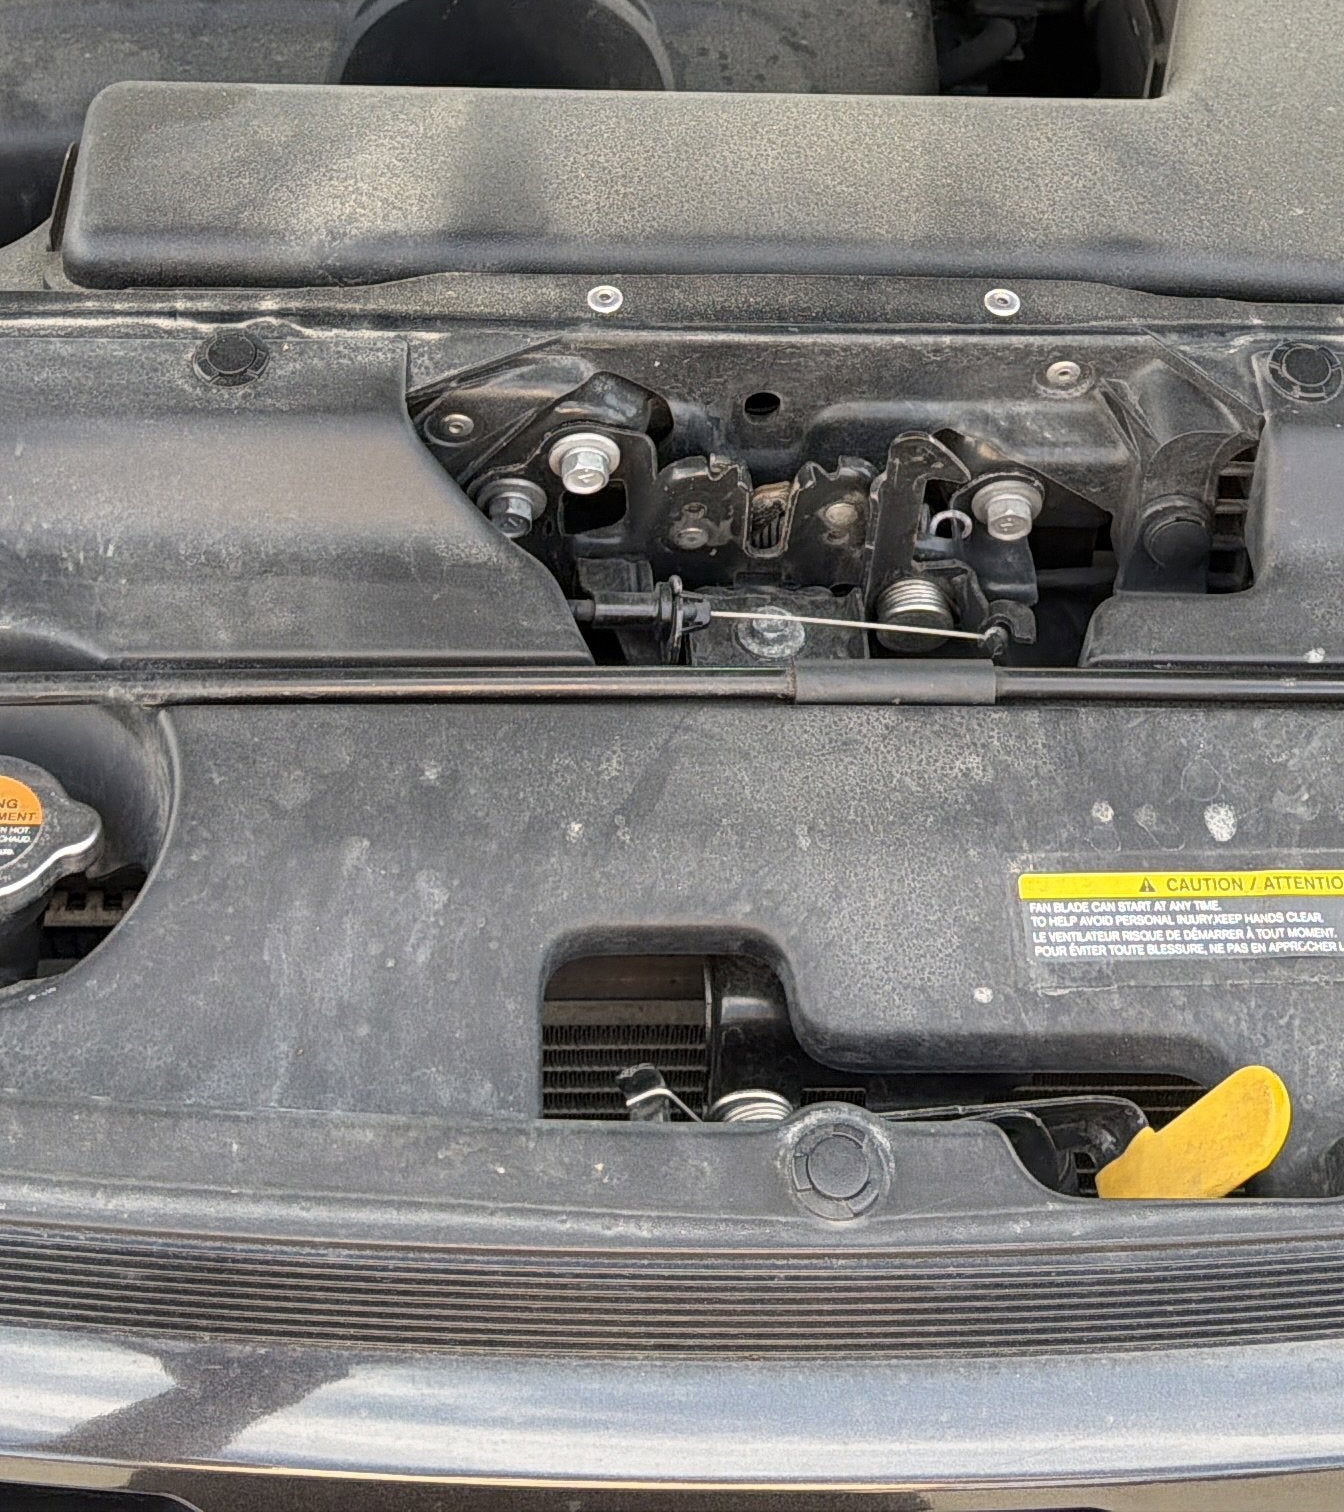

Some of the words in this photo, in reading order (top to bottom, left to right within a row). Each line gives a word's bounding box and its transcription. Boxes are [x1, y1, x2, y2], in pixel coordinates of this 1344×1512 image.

[9, 826, 32, 835] HOT.
[1166, 877, 1244, 892] CAUTION
[1029, 902, 1052, 913] FAN
[1054, 901, 1090, 913] BLADE
[1092, 901, 1116, 912] CAN
[1118, 901, 1152, 912] START
[1154, 901, 1167, 911] AT
[1169, 900, 1192, 911] ANY
[1194, 900, 1222, 911] TIME.
[1030, 916, 1047, 927] TO
[1049, 916, 1078, 927] HELP
[1080, 915, 1114, 926] AVOID
[1115, 915, 1175, 926] PERSONAL
[1244, 913, 1284, 924] HANDS
[1286, 912, 1324, 923] CLEAR.
[1032, 931, 1047, 943] LE
[1048, 931, 1120, 943] VENTILATEUR
[1122, 930, 1164, 941] RISQUE
[1166, 930, 1181, 941] DE
[1183, 927, 1245, 940] DÉMARRER
[1246, 926, 1255, 939] À
[1256, 927, 1285, 939] TOUT
[1287, 927, 1338, 938] MOMENT.
[1034, 945, 1067, 957] POUR
[1069, 943, 1107, 957] ÉVITER
[1109, 945, 1146, 956] TOUTE
[1147, 944, 1208, 956] BLESSURE,
[1209, 943, 1225, 954] NE
[1226, 943, 1249, 954] PAS
[1251, 942, 1267, 953] EN
[1268, 941, 1337, 953] APPROCHER
